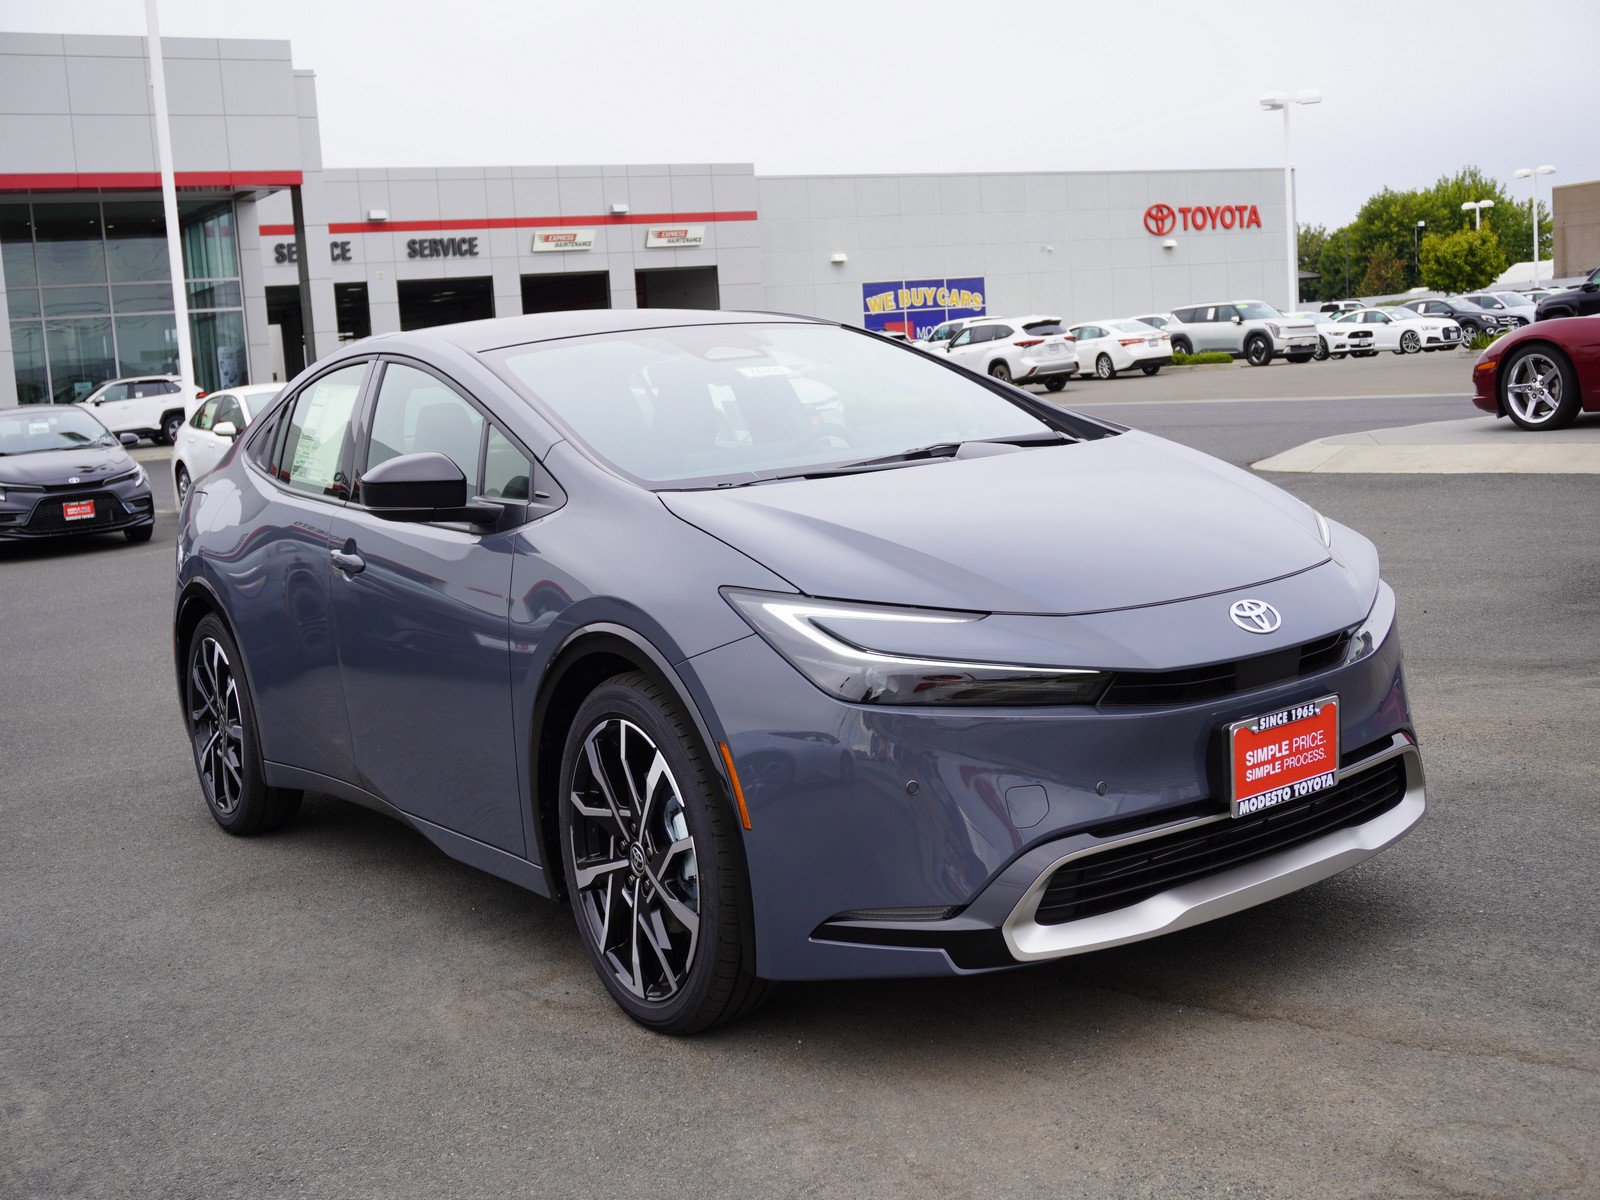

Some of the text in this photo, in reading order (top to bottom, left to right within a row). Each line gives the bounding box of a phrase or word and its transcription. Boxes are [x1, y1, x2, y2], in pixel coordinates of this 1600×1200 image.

[1178, 205, 1262, 231] TOYOTA
[548, 233, 575, 242] EXPRESS
[661, 230, 687, 238] EXPRESS
[407, 236, 480, 259] SERVICE
[866, 287, 983, 315] WE BUY CARS
[1259, 704, 1315, 730] SINCE 1965
[1245, 729, 1327, 767] SIMPLE PRICE.
[1245, 748, 1327, 782] SIMPLE PROCESS.
[1238, 773, 1334, 816] MODESTO TOYOTA
